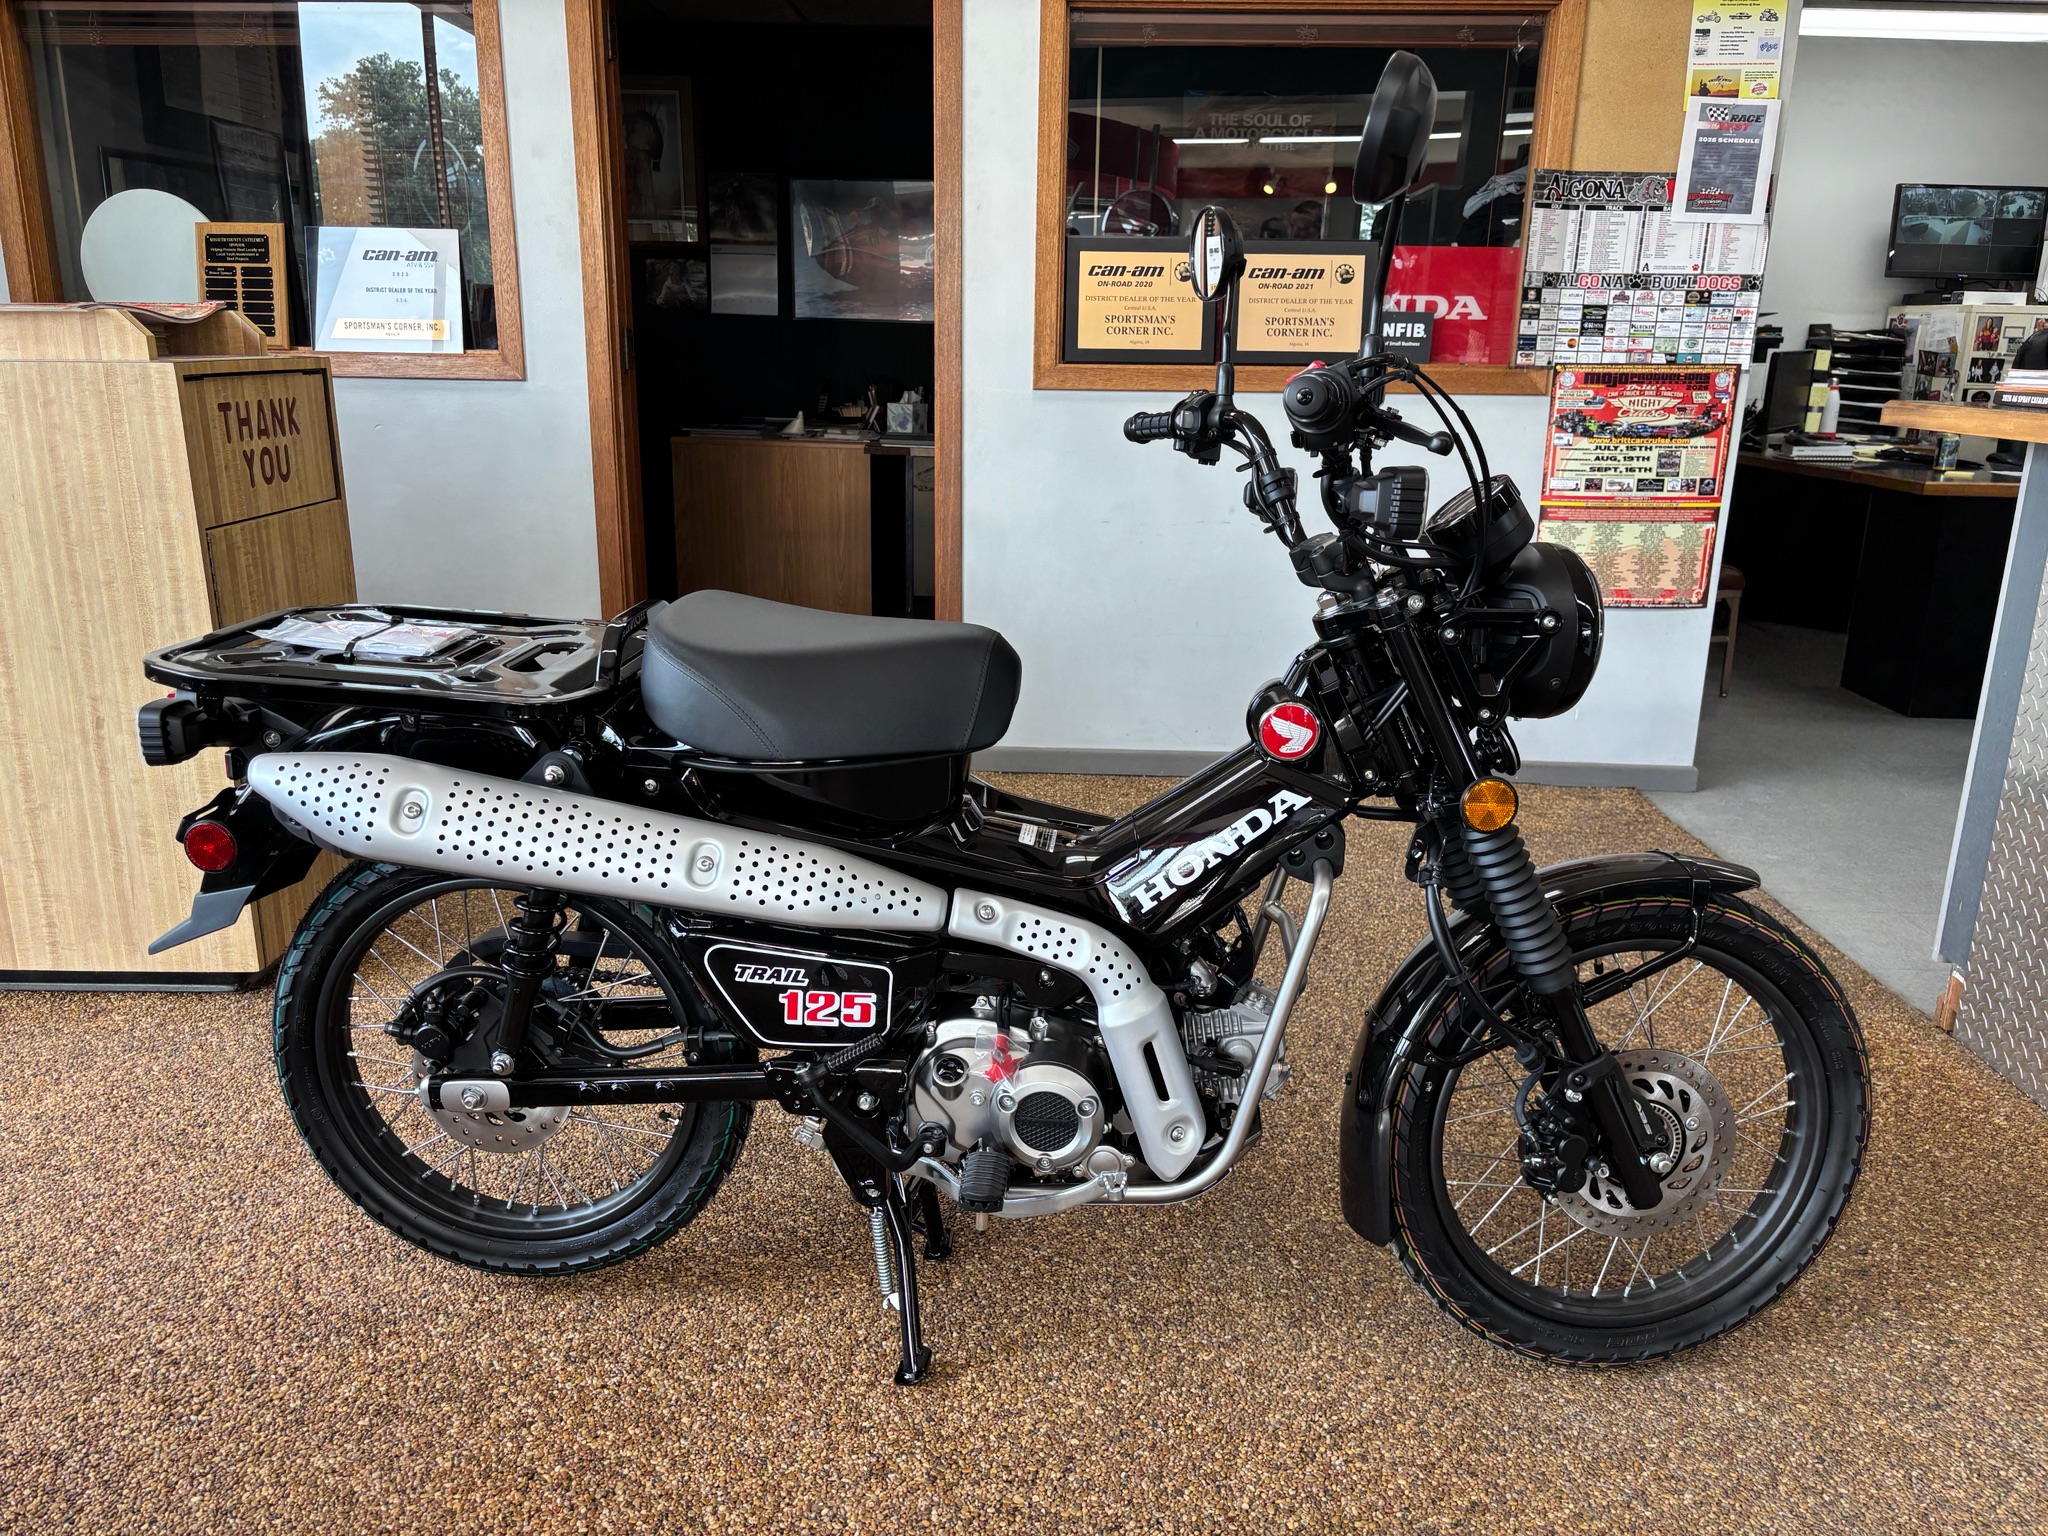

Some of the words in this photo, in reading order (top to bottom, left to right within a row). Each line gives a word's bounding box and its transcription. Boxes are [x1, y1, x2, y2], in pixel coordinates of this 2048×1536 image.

[1208, 113, 1238, 126] THE
[1242, 113, 1287, 127] SOUL
[1288, 114, 1312, 127] OF
[1730, 114, 1764, 123] RACE
[1210, 127, 1322, 140] MOTORCYCLE
[1544, 172, 1626, 201] ALGONA
[362, 249, 438, 262] can-am
[1088, 264, 1164, 278] can-am
[1248, 267, 1326, 280] can-am
[1097, 280, 1132, 288] ON-ROAD
[1558, 274, 1624, 288] ALGONA
[1650, 275, 1742, 290] BULLDOGS
[1104, 314, 1176, 324] SPORTSMAN'S
[1264, 316, 1335, 327] SPORTSMAN'S
[344, 322, 392, 330] SPORTSMAN'S
[394, 322, 424, 332] CORNER,
[426, 323, 441, 332] INC.
[1106, 326, 1150, 336] CORNER
[1152, 327, 1174, 336] INC.
[1266, 328, 1309, 337] CORNER
[1312, 328, 1333, 338] INC.
[1628, 399, 1662, 408] NIGHT
[2018, 395, 2031, 403] SPRAY
[1618, 408, 1666, 418] Cruise
[217, 396, 300, 444] THANK
[1587, 436, 1690, 444] www.brittcarcruise.com
[1593, 455, 1621, 463] AUG,
[242, 444, 291, 489] YOU
[1130, 789, 1312, 914] HONDA
[734, 964, 809, 987] TRAIL
[778, 989, 877, 1028] 125
